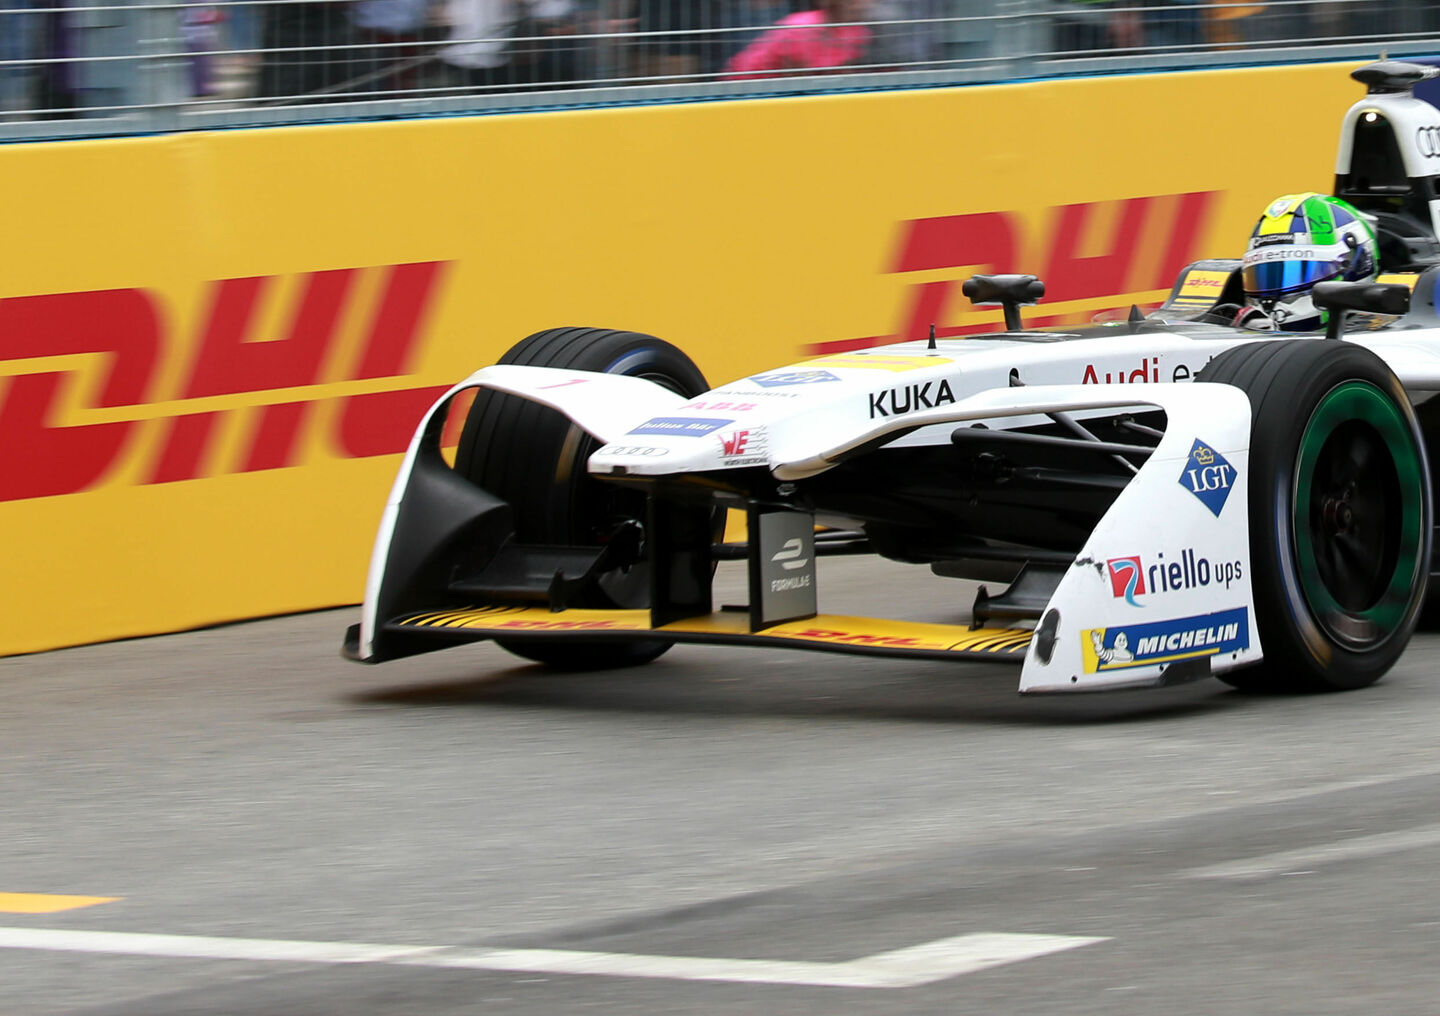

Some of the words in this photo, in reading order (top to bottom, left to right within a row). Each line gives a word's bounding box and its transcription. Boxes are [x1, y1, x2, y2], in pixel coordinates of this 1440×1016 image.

[0, 259, 460, 502] DHL
[869, 379, 956, 419] KUKA
[1187, 464, 1230, 492] LGT
[1148, 548, 1211, 594] riello
[1215, 560, 1242, 590] ups
[1136, 623, 1239, 655] MICHELIN
